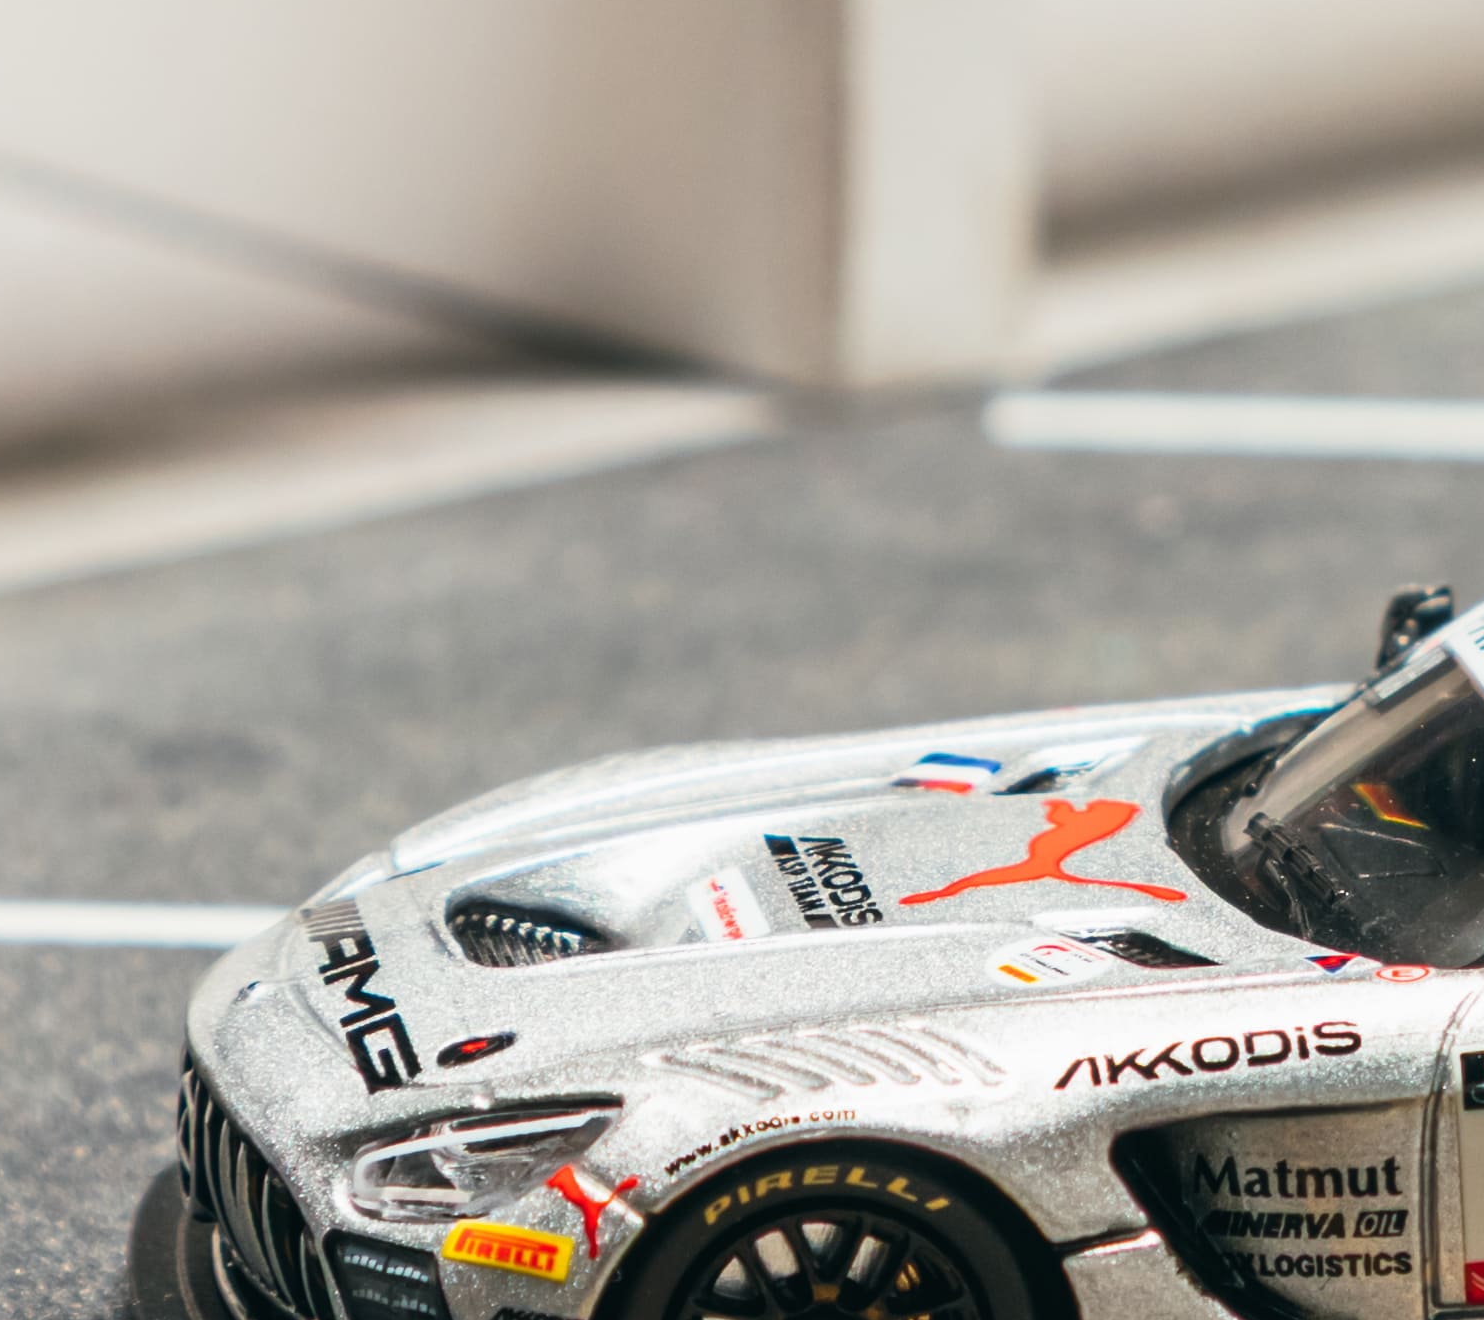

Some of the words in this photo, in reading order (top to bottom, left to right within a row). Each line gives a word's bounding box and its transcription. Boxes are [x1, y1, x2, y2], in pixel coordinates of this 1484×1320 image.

[308, 930, 424, 1095] AMG
[703, 1165, 953, 1226] PIRELLI
[1193, 1153, 1404, 1199] Matmut
[1355, 1209, 1409, 1238] OIL
[453, 1227, 559, 1274] PIRELLI
[1259, 1252, 1413, 1278] LOGISTICS
